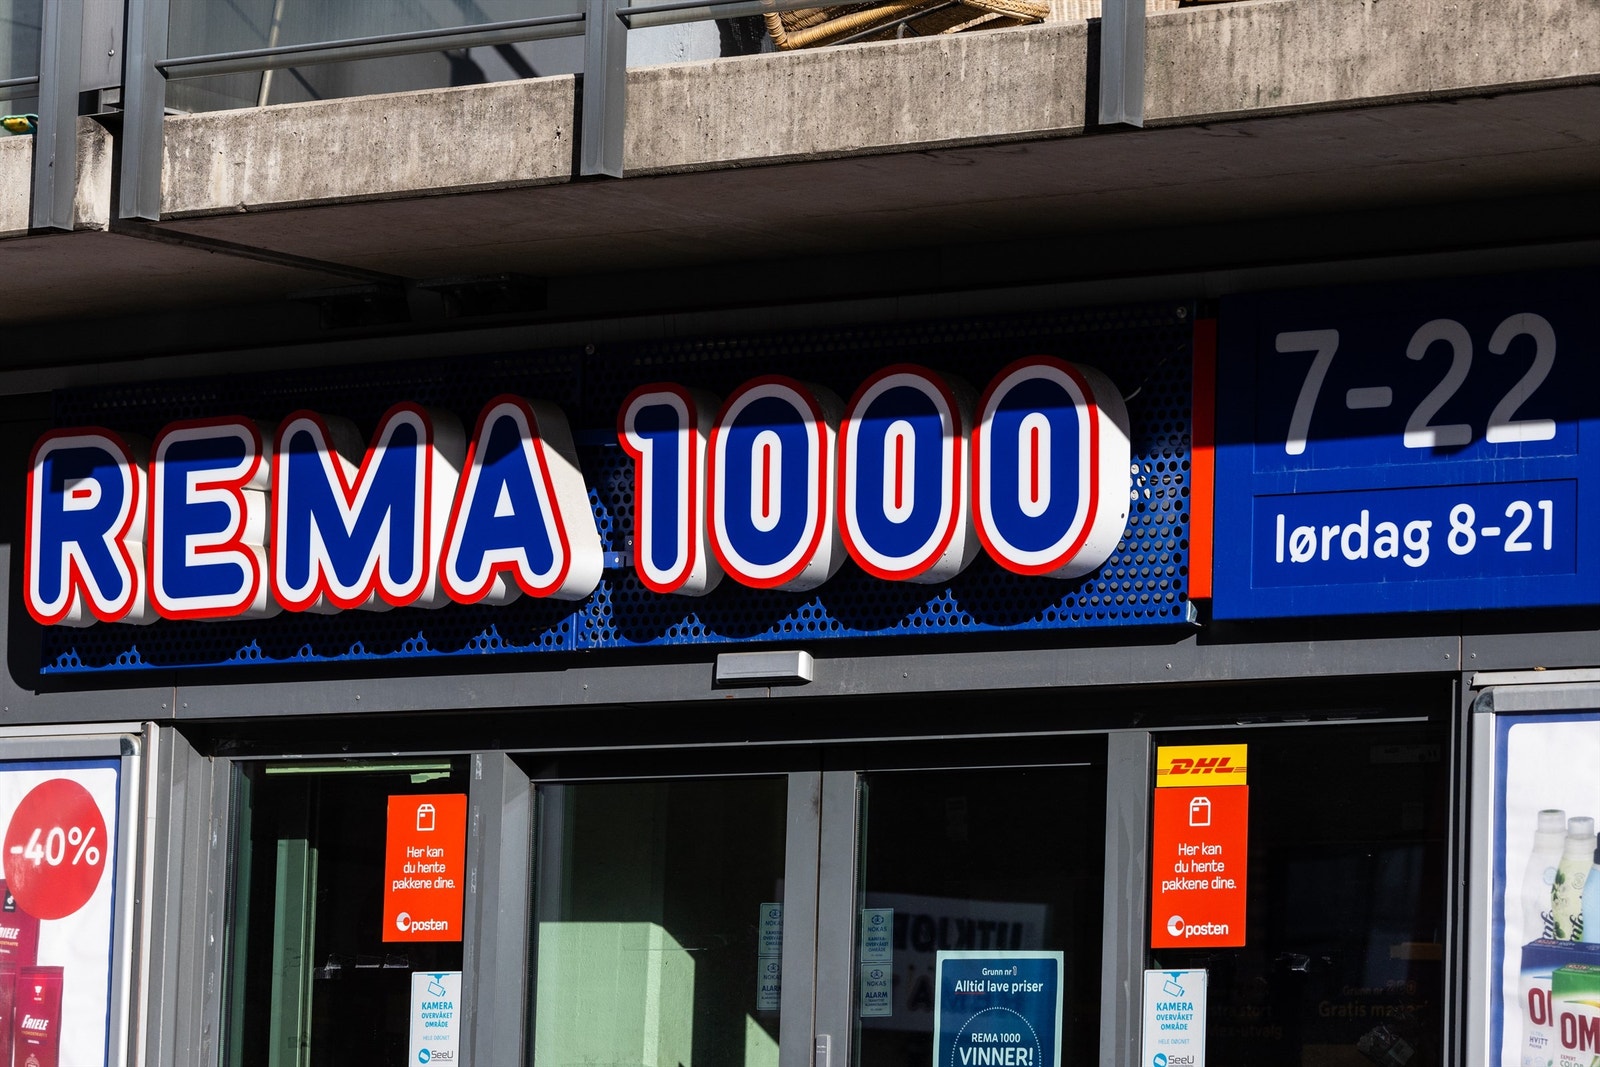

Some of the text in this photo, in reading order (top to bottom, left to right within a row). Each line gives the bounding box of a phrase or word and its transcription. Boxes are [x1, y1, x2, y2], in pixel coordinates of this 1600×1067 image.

[1275, 312, 1557, 455] 7-22
[24, 354, 1102, 626] REMA 1000
[1275, 500, 1554, 568] lørdag 8-21
[1169, 757, 1235, 775] DHL
[10, 825, 100, 867] -40%
[406, 846, 444, 858] Her kan
[1178, 842, 1222, 856] Her kan
[403, 861, 446, 874] du hente
[1174, 859, 1225, 873] du hente
[392, 877, 455, 892] pakkene dine.
[1162, 876, 1237, 893] pakkene dine.
[411, 919, 448, 934] posten
[1185, 921, 1229, 938] posten
[982, 967, 1003, 976] Grunn
[955, 980, 1044, 994] Alltid lave priser
[421, 1001, 453, 1010] KAMERA
[1156, 1002, 1193, 1011] KAMERA
[421, 1011, 453, 1019] OVERVÅKET
[1156, 1012, 1193, 1020] OVERVÅKET
[21, 1014, 49, 1031] FRIELE
[425, 1019, 448, 1028] OMRÅDE
[1160, 1022, 1188, 1031] OMRÅDE
[971, 1033, 1021, 1043] REMA 1000
[1529, 1036, 1549, 1046] HVITT
[431, 1050, 454, 1059] SeeU
[959, 1047, 1034, 1067] VINNER!
[1168, 1055, 1195, 1064] SeeU
